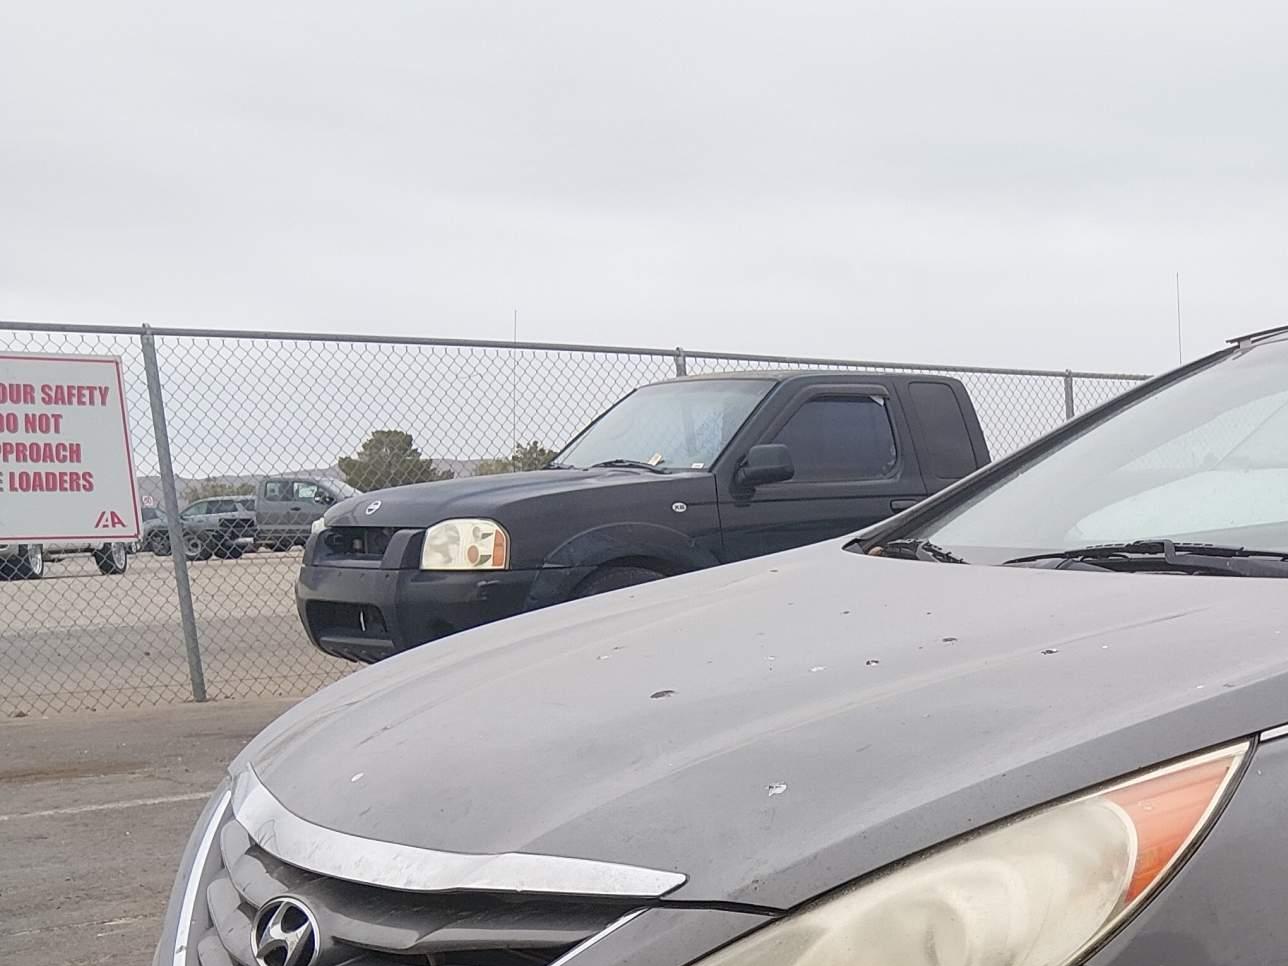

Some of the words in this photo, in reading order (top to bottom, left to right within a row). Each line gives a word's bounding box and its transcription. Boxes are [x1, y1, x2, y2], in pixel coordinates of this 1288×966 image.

[41, 384, 110, 406] SAFETY
[24, 413, 63, 434] NOT
[0, 442, 82, 464] PROACH
[9, 471, 95, 492] LOADERS
